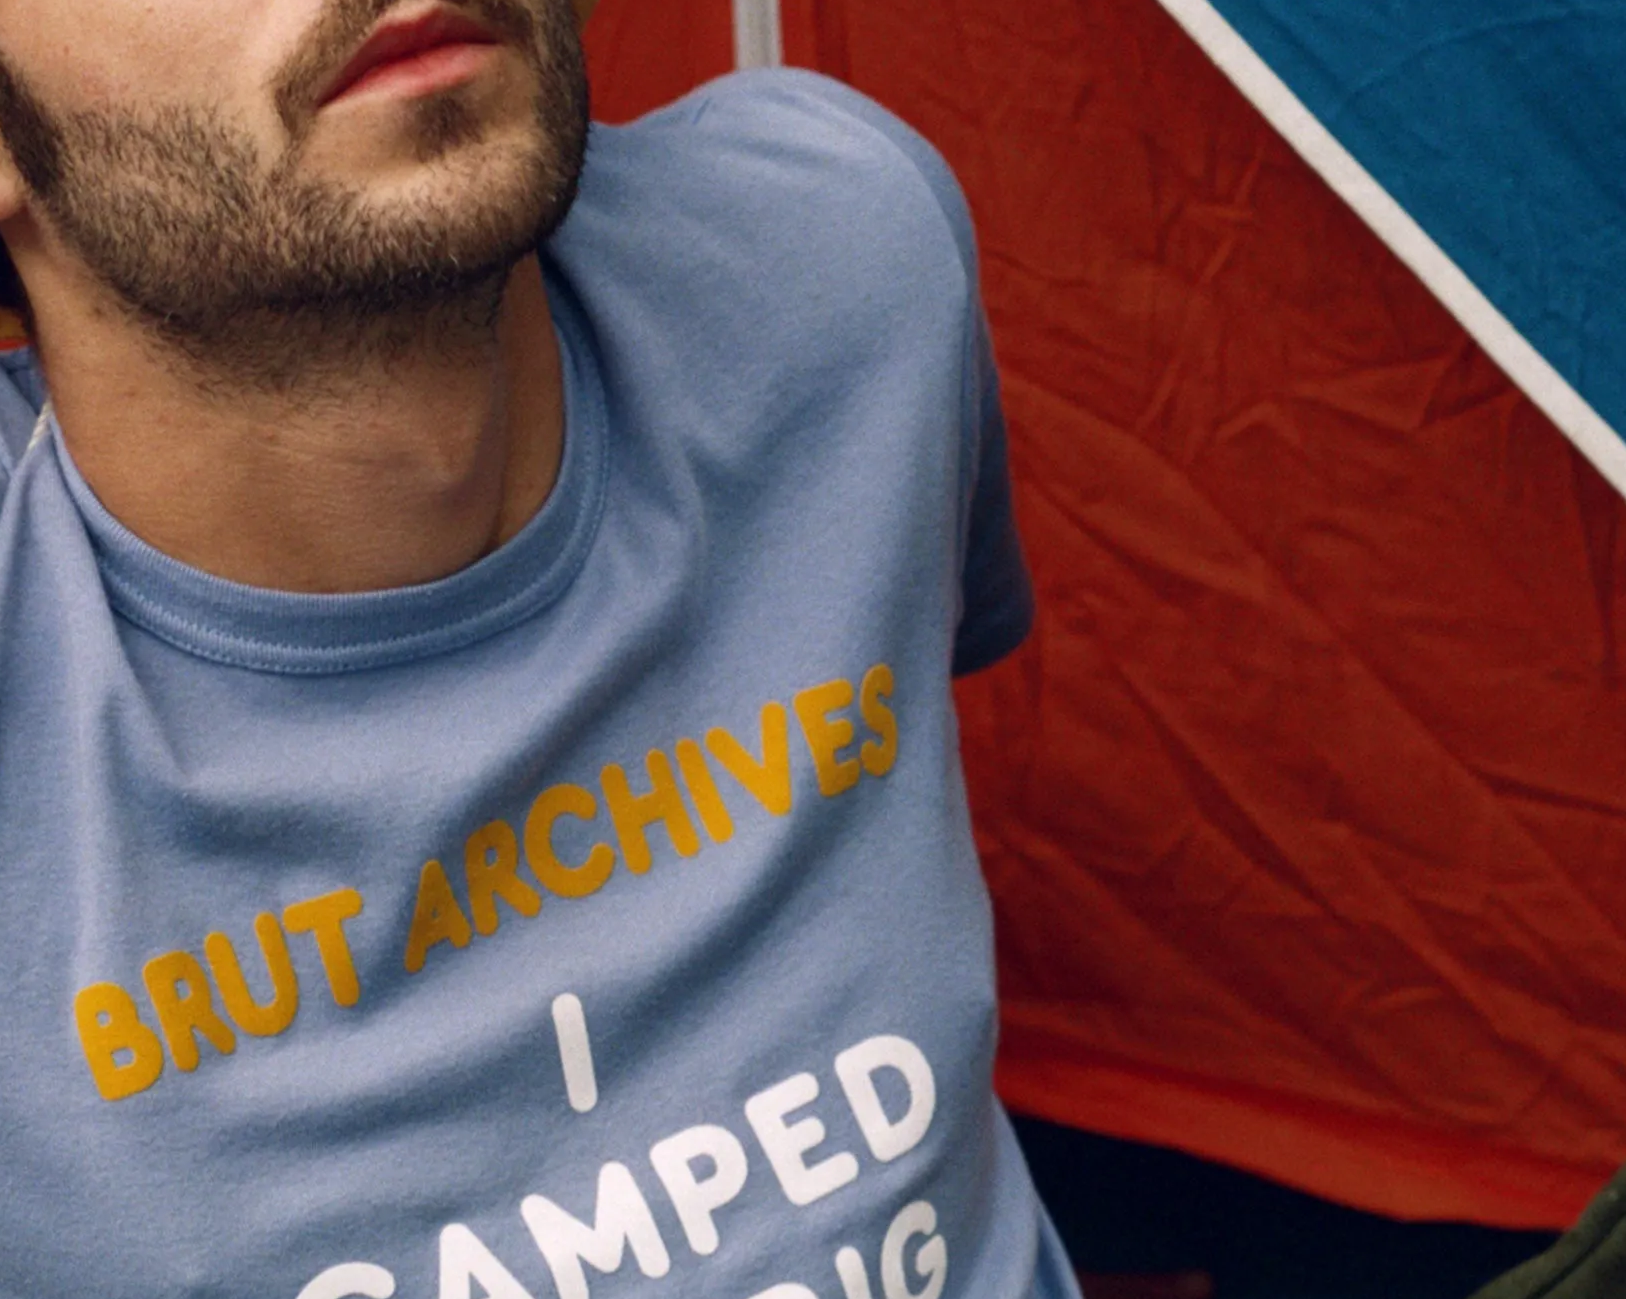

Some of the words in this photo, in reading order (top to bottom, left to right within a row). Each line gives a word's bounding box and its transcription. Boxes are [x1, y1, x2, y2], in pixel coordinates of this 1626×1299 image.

[73, 887, 364, 1102] BRUT
[403, 663, 900, 974] ARCHIVES
[551, 992, 599, 1114] I
